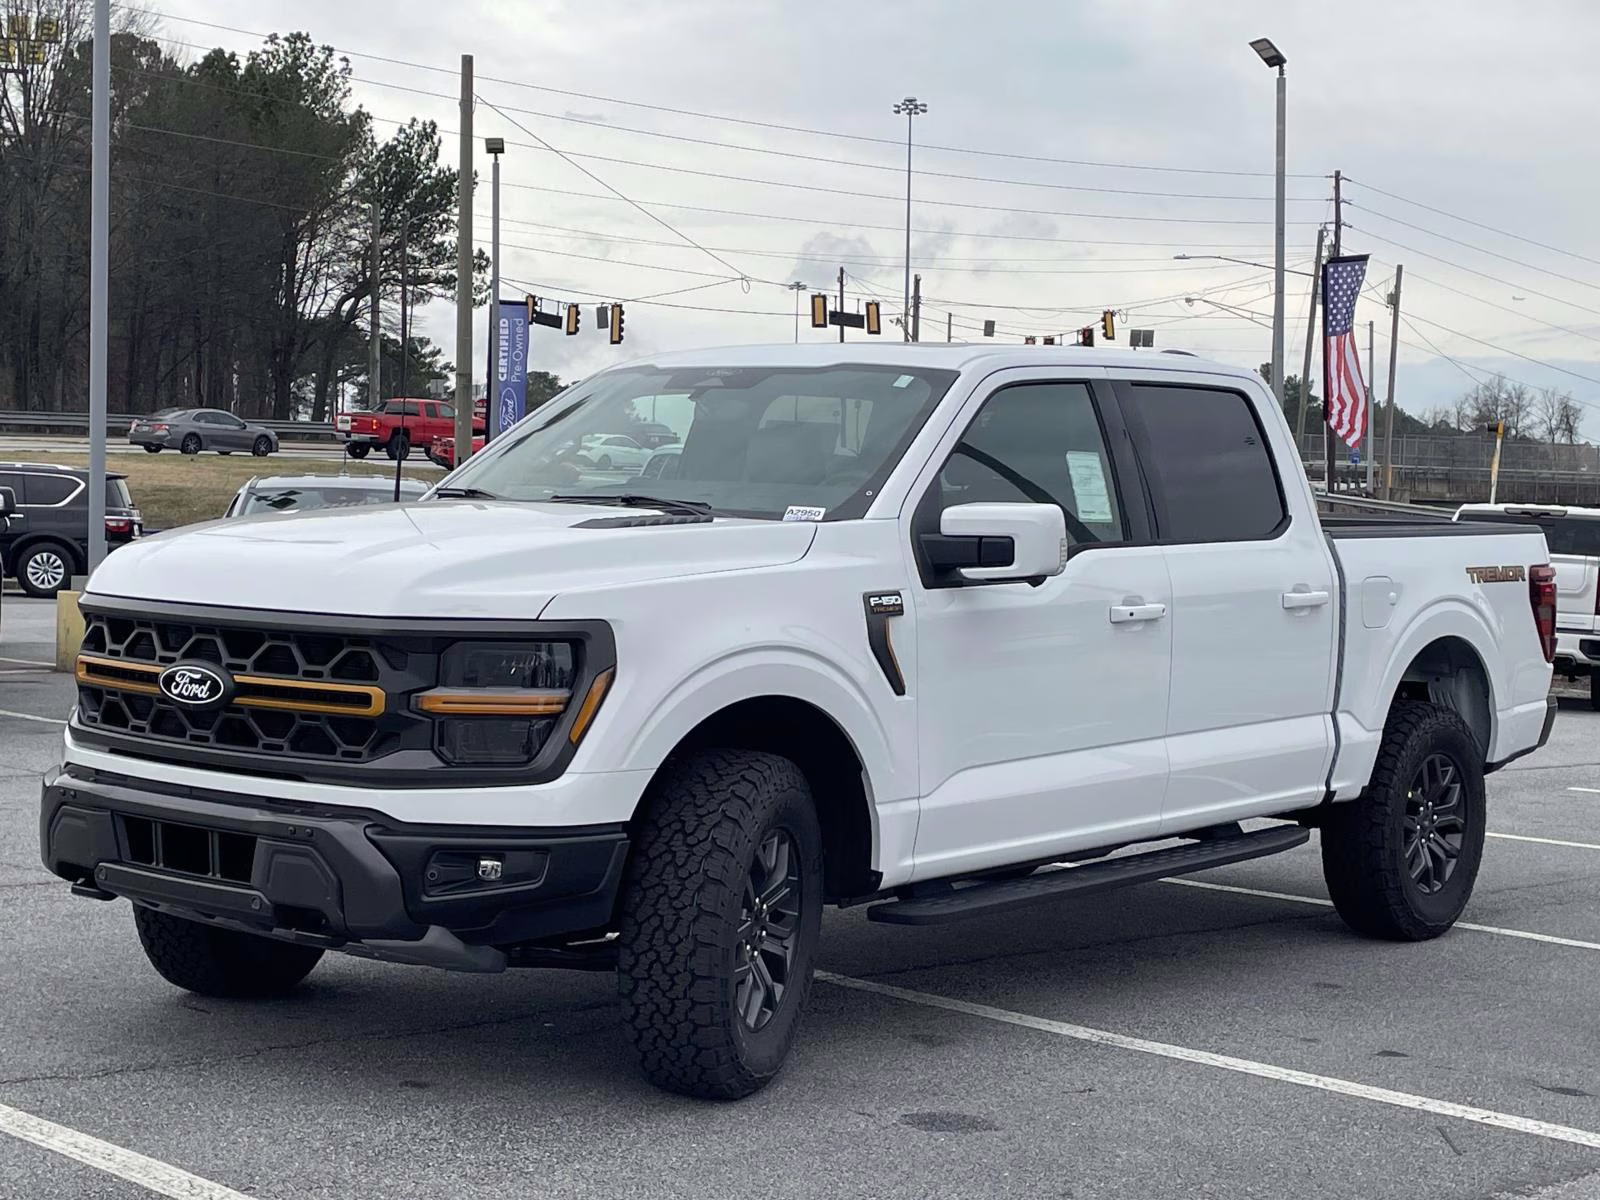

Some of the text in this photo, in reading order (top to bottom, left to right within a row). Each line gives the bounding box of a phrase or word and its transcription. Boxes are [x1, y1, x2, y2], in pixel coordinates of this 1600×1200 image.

[499, 318, 509, 381] CERTIFIED
[511, 318, 524, 382] Pre-Owned
[501, 398, 514, 429] Ford
[1465, 566, 1526, 584] TREMOR
[869, 595, 902, 606] F-150
[171, 670, 211, 698] Ford
